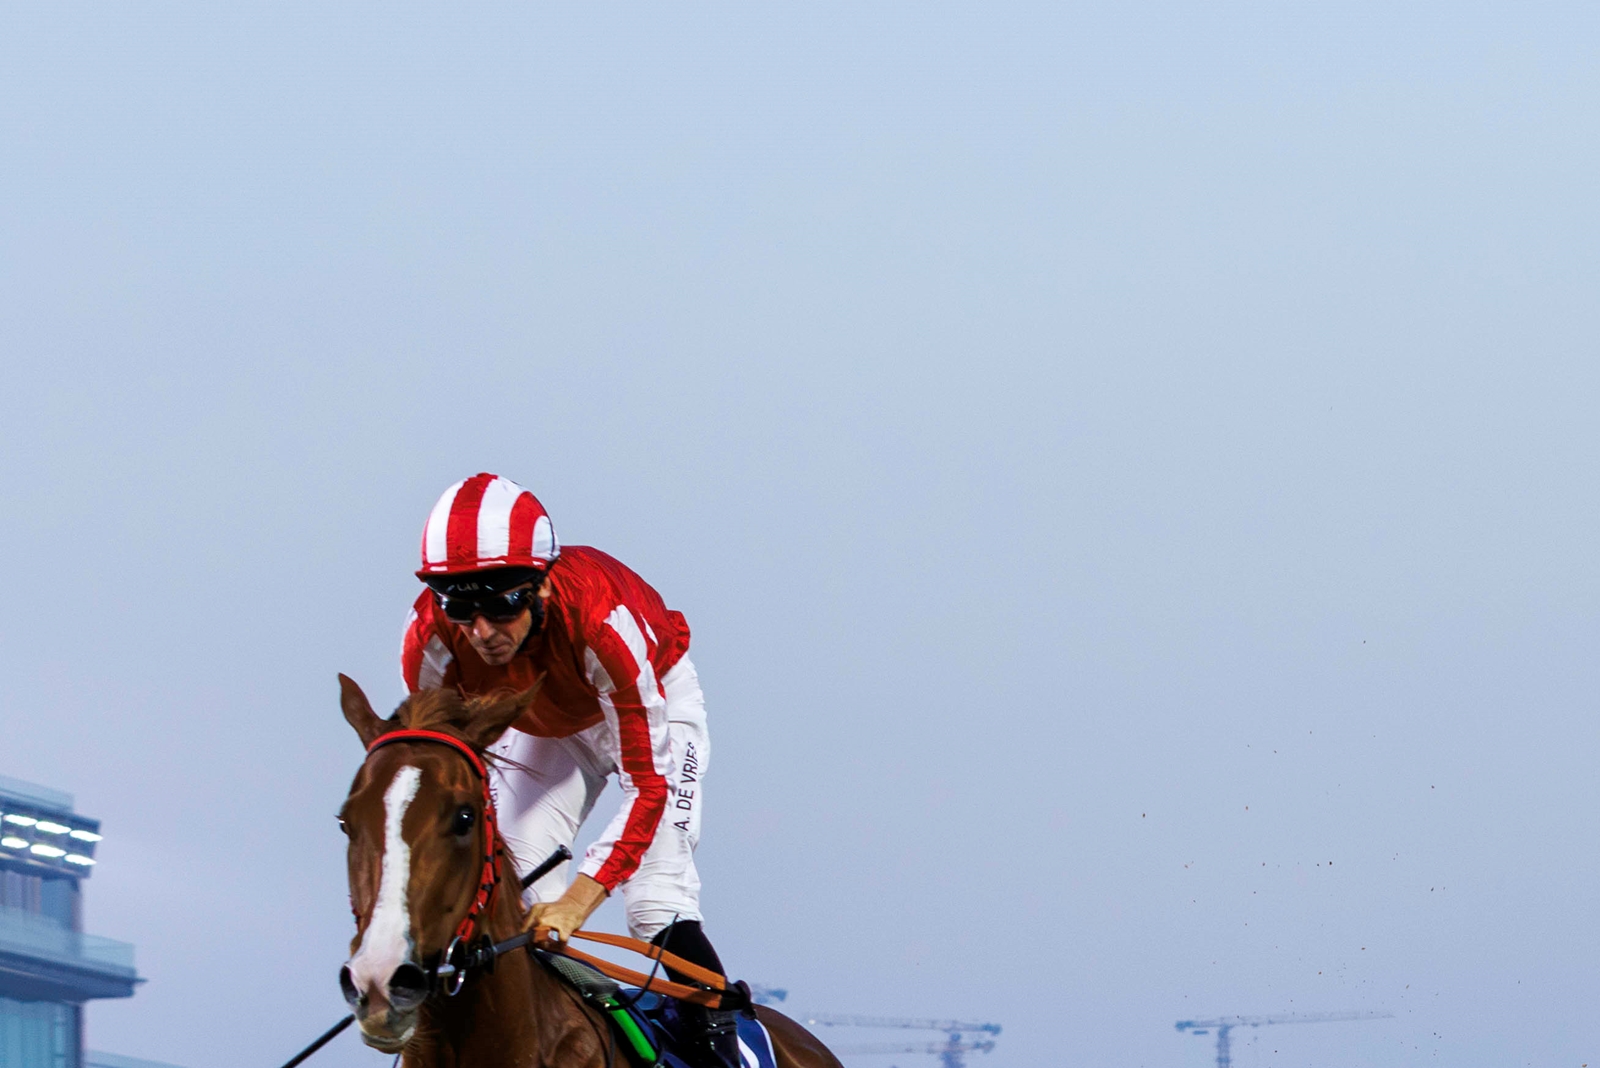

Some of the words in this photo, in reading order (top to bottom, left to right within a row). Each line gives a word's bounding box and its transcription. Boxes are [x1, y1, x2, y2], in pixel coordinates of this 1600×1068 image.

[680, 741, 698, 783] VRIES
[676, 788, 694, 811] DE
[673, 816, 690, 832] A.
